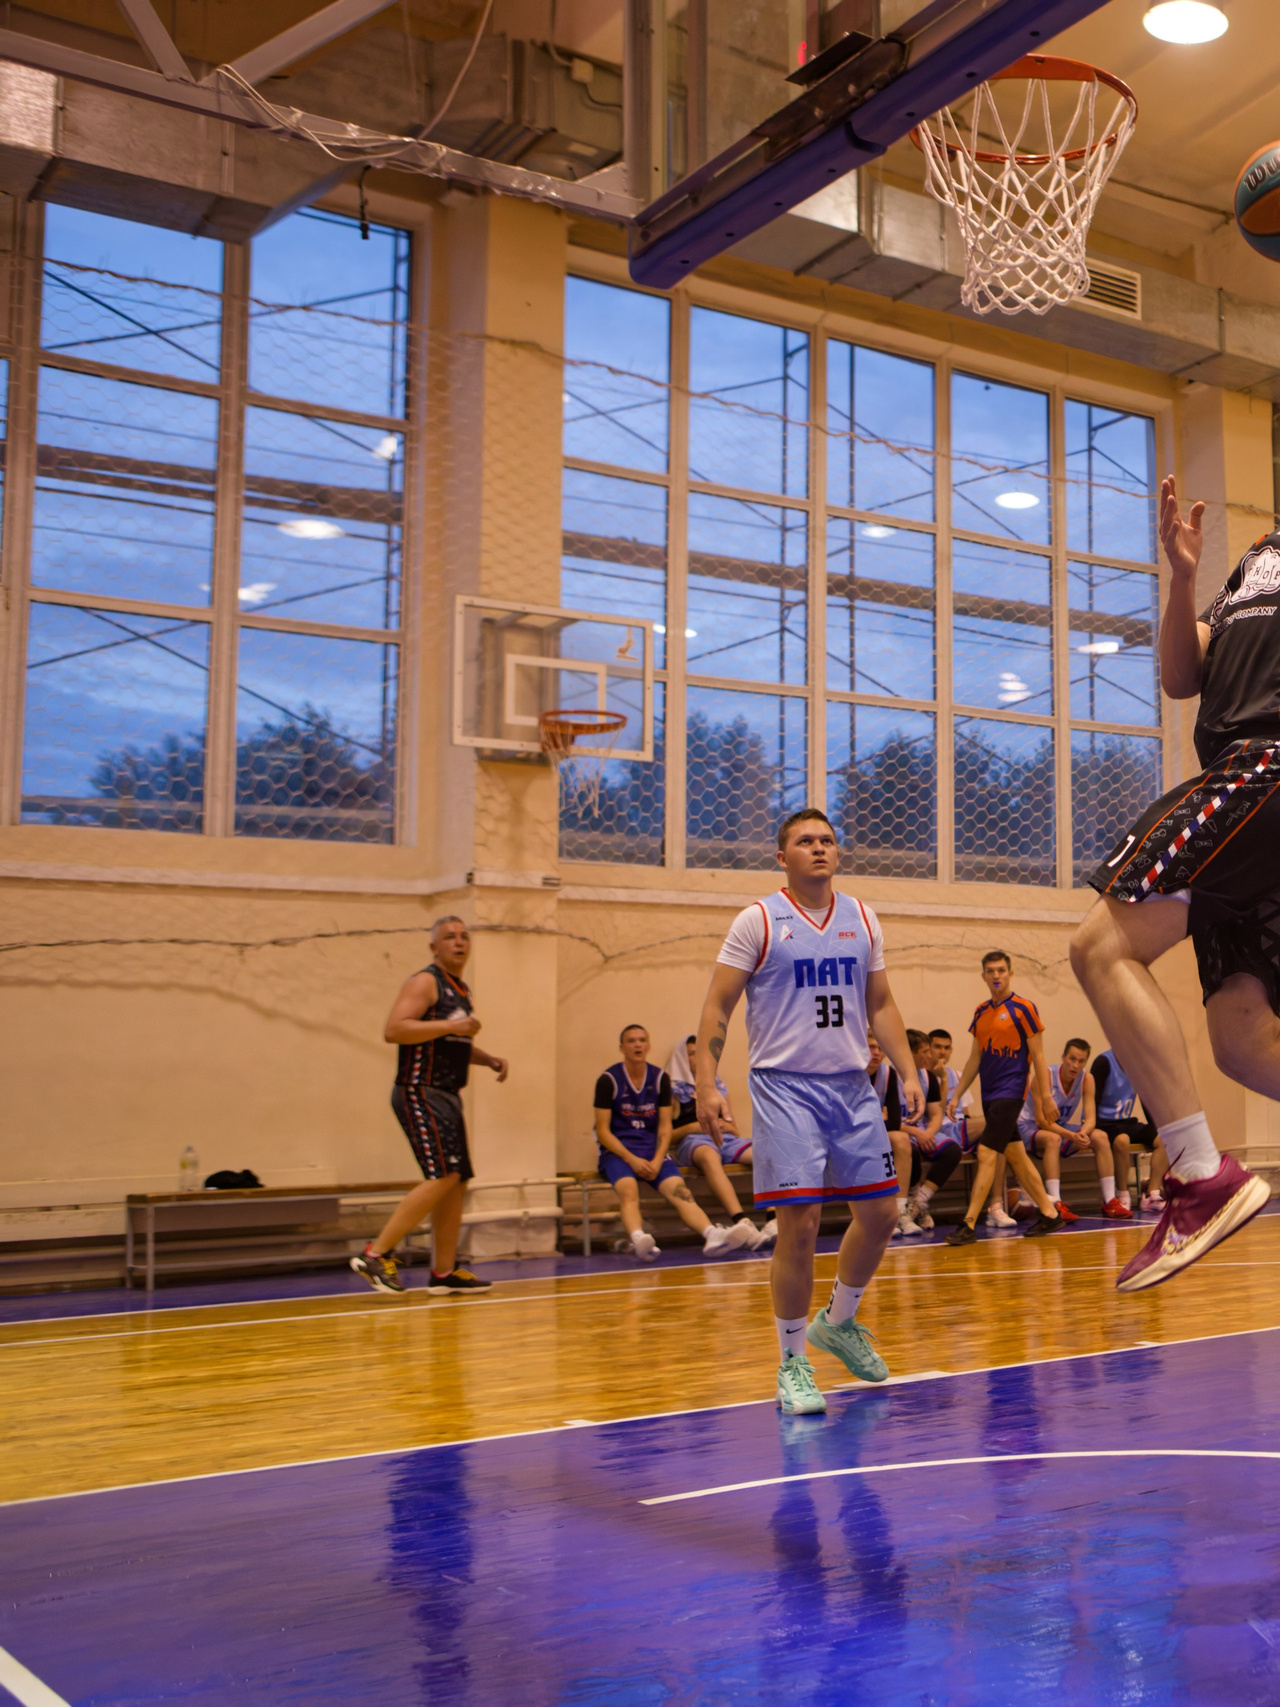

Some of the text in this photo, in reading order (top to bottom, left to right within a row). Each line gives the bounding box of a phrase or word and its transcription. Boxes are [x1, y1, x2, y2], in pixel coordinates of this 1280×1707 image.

[793, 957, 858, 988] ПАТ
[815, 995, 844, 1028] 33
[1114, 1098, 1133, 1120] 10
